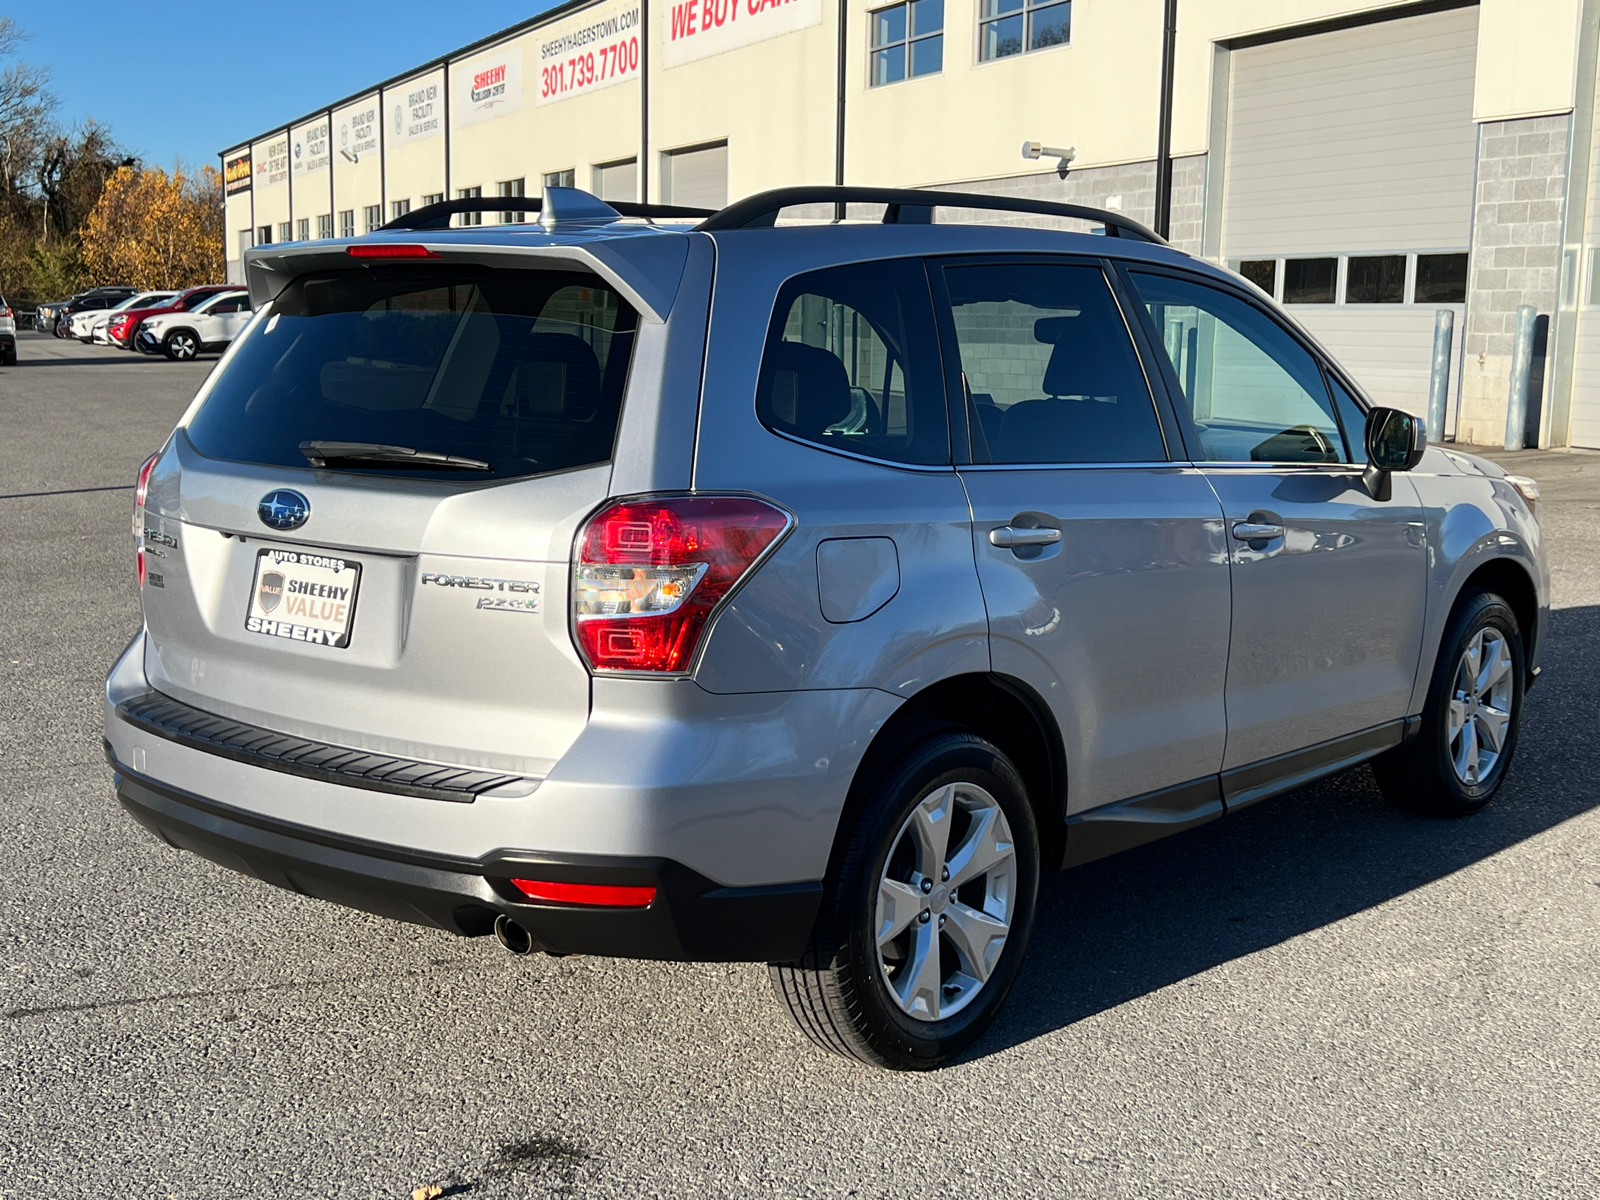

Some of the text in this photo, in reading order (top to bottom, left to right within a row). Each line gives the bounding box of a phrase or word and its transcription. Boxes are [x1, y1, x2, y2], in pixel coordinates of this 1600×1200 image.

[671, 0, 698, 41] WE
[701, 0, 739, 31] BUY
[541, 8, 639, 60] SHEEHYHAGERSTOWN.COM
[474, 64, 507, 90] SHEEHY
[542, 36, 639, 98] 301.739.7700
[409, 85, 437, 108] BRAND NEW
[352, 109, 375, 128] BRAND NEW
[412, 102, 433, 121] FACILITY
[306, 123, 328, 144] BRAND NEW
[355, 124, 372, 140] FACILITY
[409, 124, 419, 136] SALES
[423, 118, 438, 131] SERVICE
[309, 140, 325, 156] FACILITY
[268, 550, 345, 570] AUTO STORES
[261, 584, 282, 595] VALUE
[288, 579, 349, 600] SHEEHY
[422, 573, 540, 594] FORESTER
[286, 596, 346, 623] VALUE
[247, 617, 344, 646] SHEEHY
